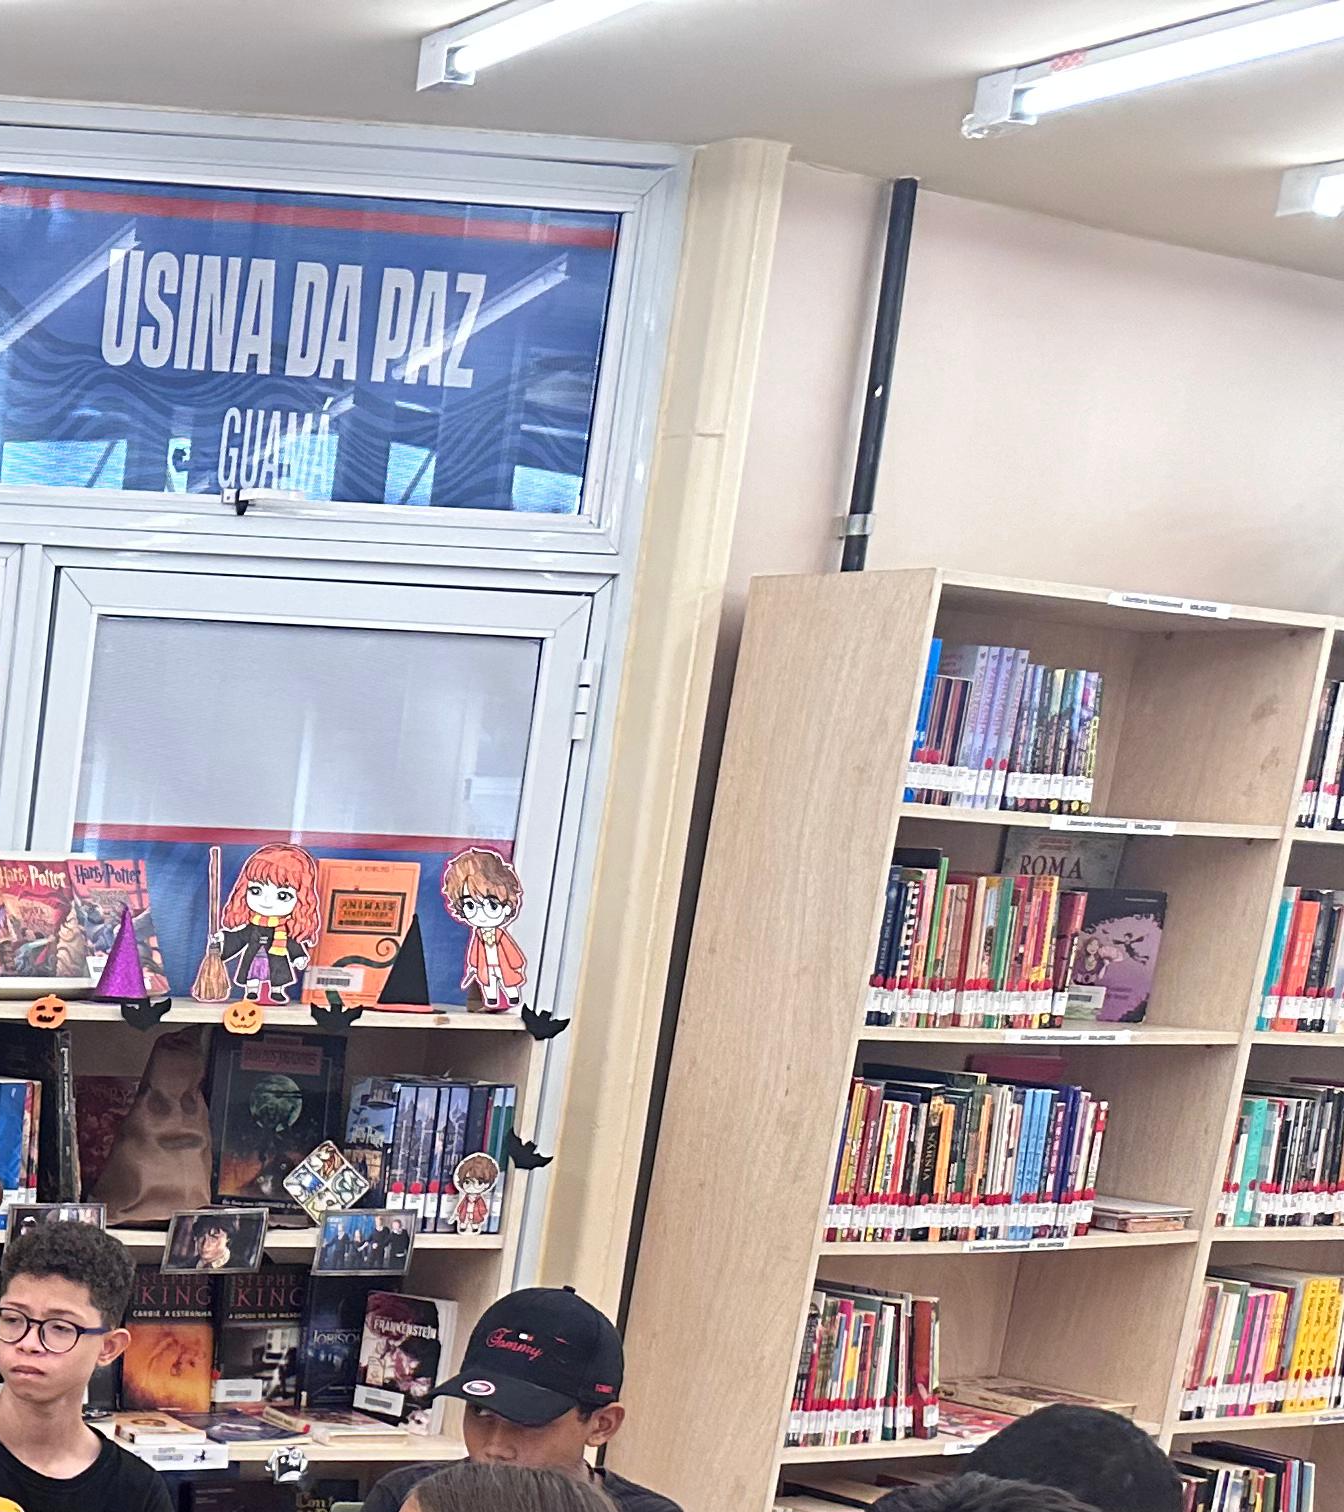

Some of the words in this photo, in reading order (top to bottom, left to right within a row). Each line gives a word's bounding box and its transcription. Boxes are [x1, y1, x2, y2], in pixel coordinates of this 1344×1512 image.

[102, 248, 277, 375] USINA
[286, 261, 364, 381] DA
[370, 268, 487, 389] PAZ
[217, 398, 333, 492] GUAMÁ
[0, 867, 29, 888] Harry
[29, 864, 66, 889] Potter
[75, 864, 105, 885] Harry
[105, 863, 142, 885] Potter
[1019, 855, 1082, 880] ROMA
[238, 1274, 300, 1286] STEPHE
[141, 1285, 212, 1306] KING
[373, 1318, 437, 1339] FRANKENSTEIN
[486, 1327, 544, 1362] Tommy
